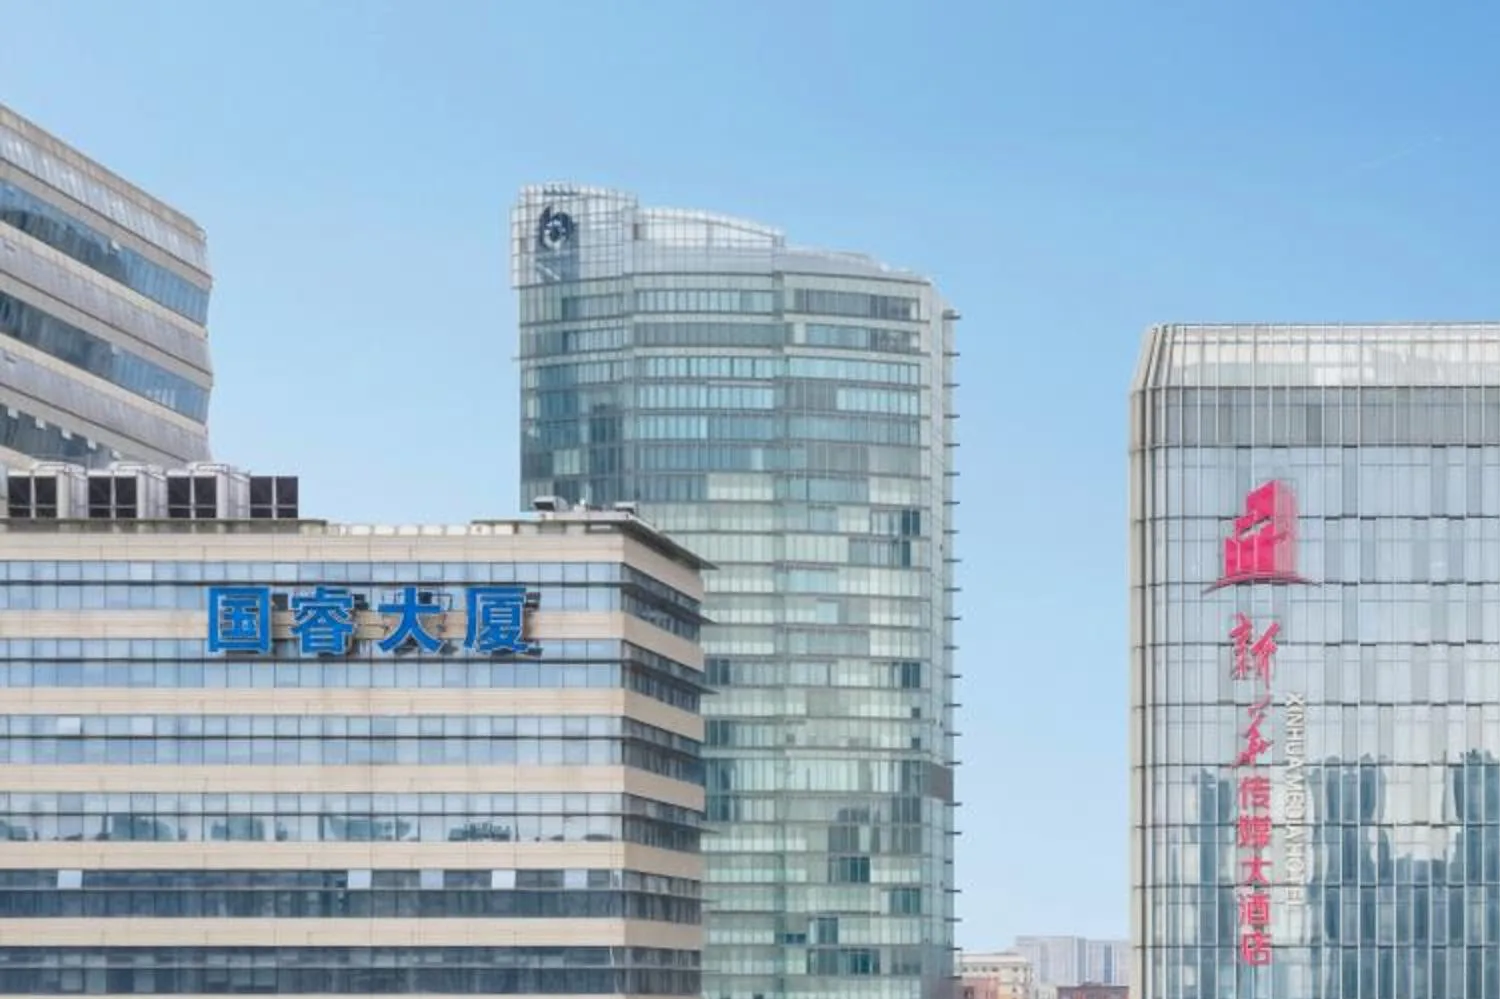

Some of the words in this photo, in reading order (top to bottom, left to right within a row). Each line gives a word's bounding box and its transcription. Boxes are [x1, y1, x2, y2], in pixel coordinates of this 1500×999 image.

[208, 586, 532, 655] 国睿大厦
[1285, 692, 1305, 770] XINHUA
[1285, 774, 1305, 839] MEDIA
